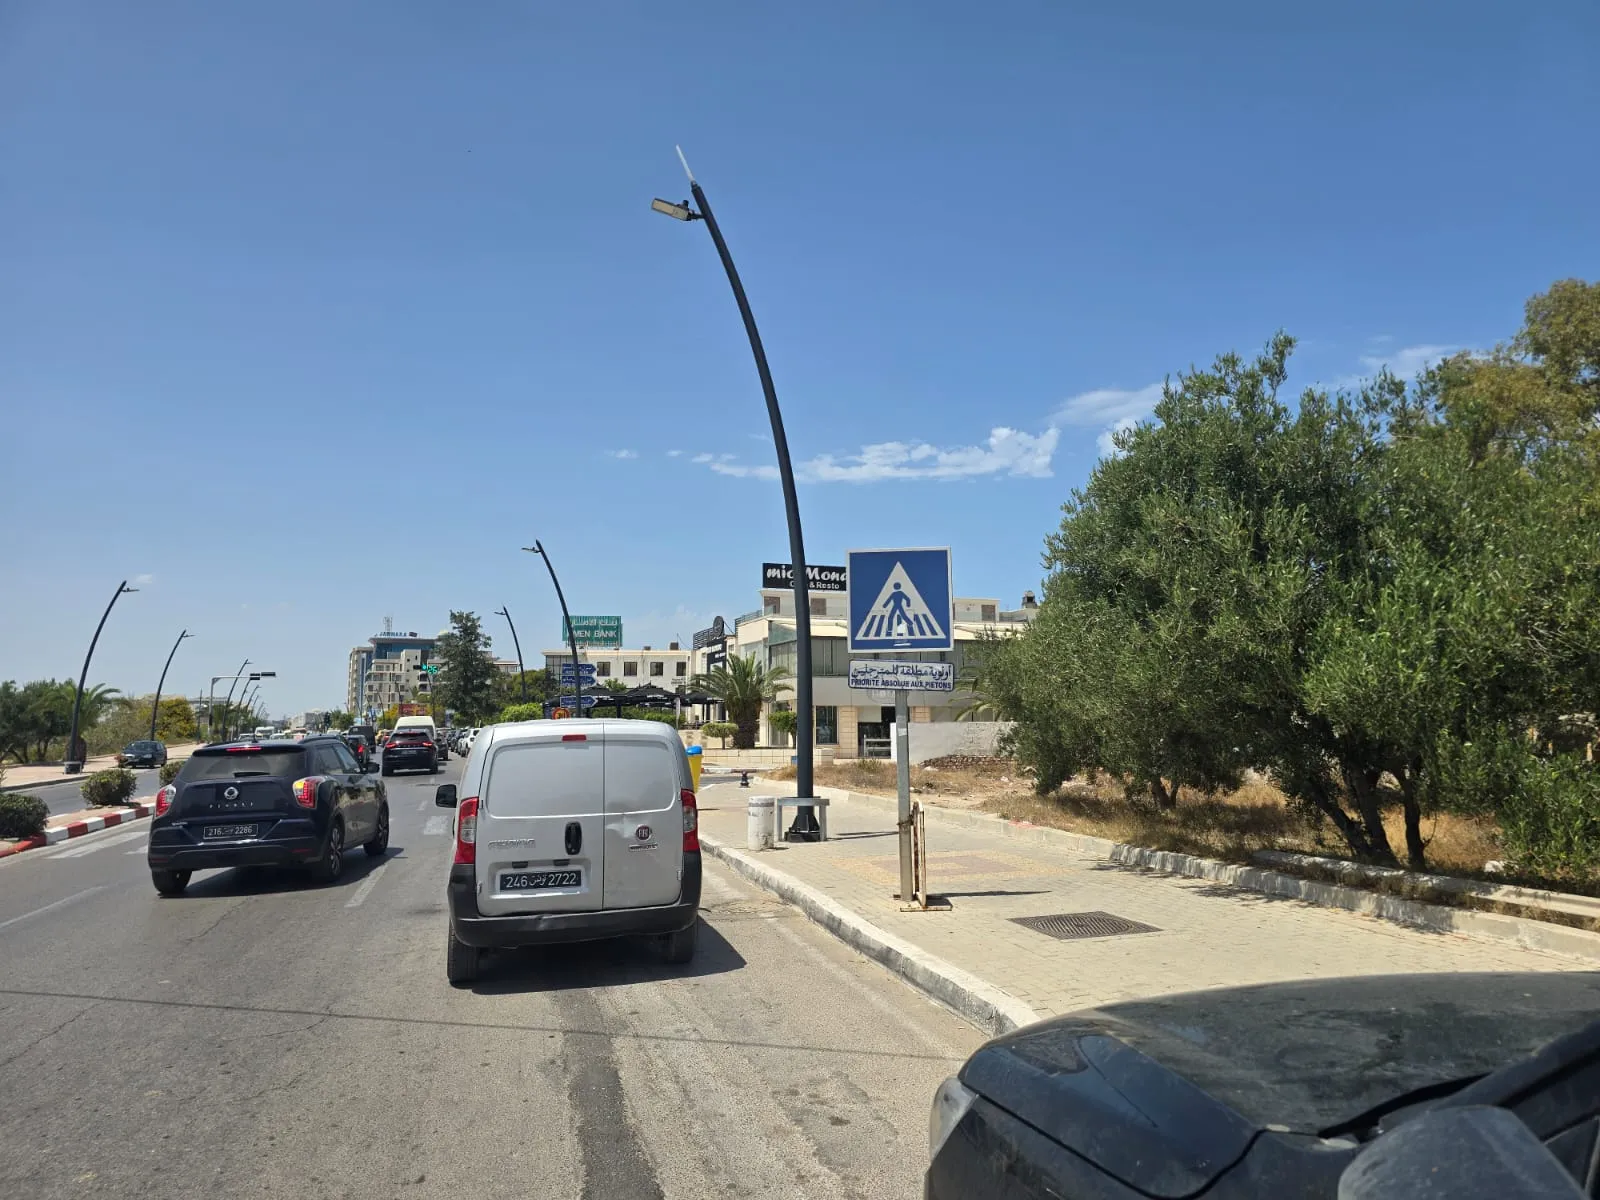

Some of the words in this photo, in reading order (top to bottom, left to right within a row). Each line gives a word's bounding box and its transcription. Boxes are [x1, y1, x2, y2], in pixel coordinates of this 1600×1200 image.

[816, 581, 840, 590] Resto
[594, 629, 617, 639] BANK
[851, 678, 880, 687] PRIORITE
[881, 679, 910, 688] ABSOLUE
[910, 680, 924, 689] AUX
[925, 681, 952, 690] PIETONS
[506, 875, 528, 888] 246
[547, 872, 577, 886] 2722
